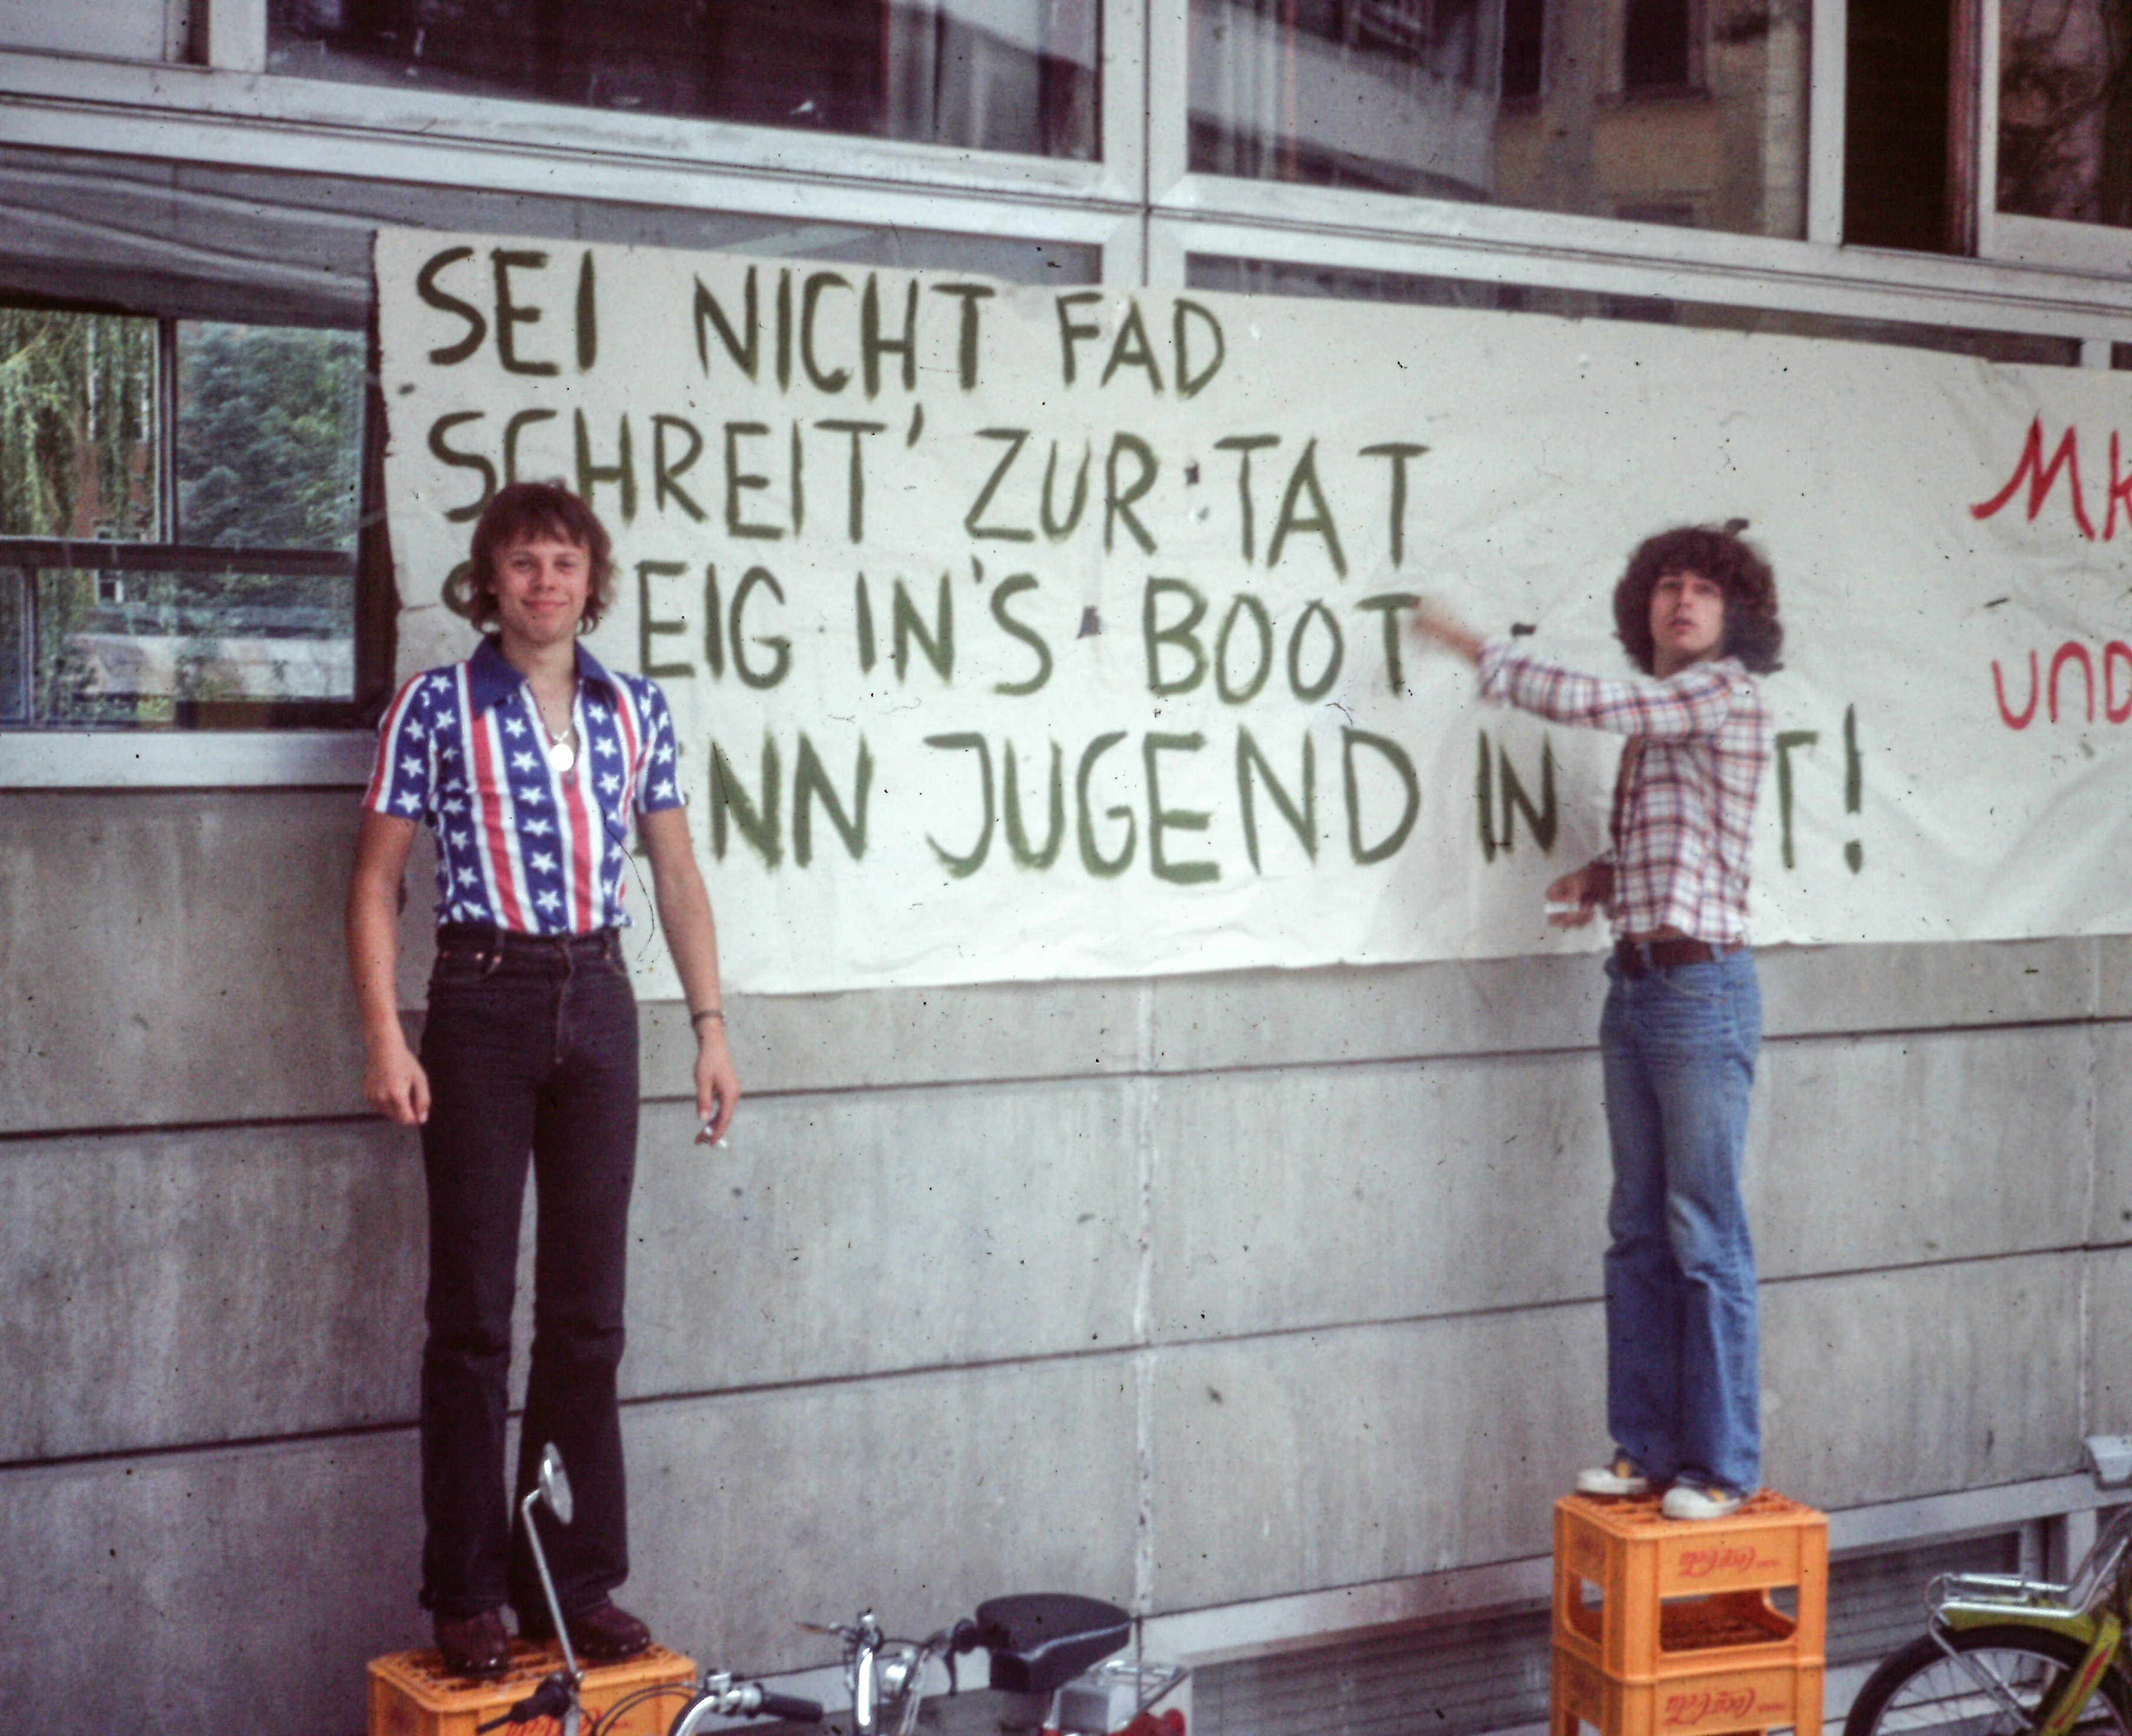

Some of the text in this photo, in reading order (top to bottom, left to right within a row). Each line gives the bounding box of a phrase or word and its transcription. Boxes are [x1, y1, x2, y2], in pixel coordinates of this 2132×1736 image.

[416, 246, 1226, 402] SEI NICHT FAD
[965, 426, 1158, 555] ZUR
[1213, 434, 1432, 579] TAT
[856, 555, 1053, 697] IN'S
[1142, 575, 1421, 706] BOOT
[923, 724, 1422, 885] JUGEND
[1476, 728, 1558, 864] IN
